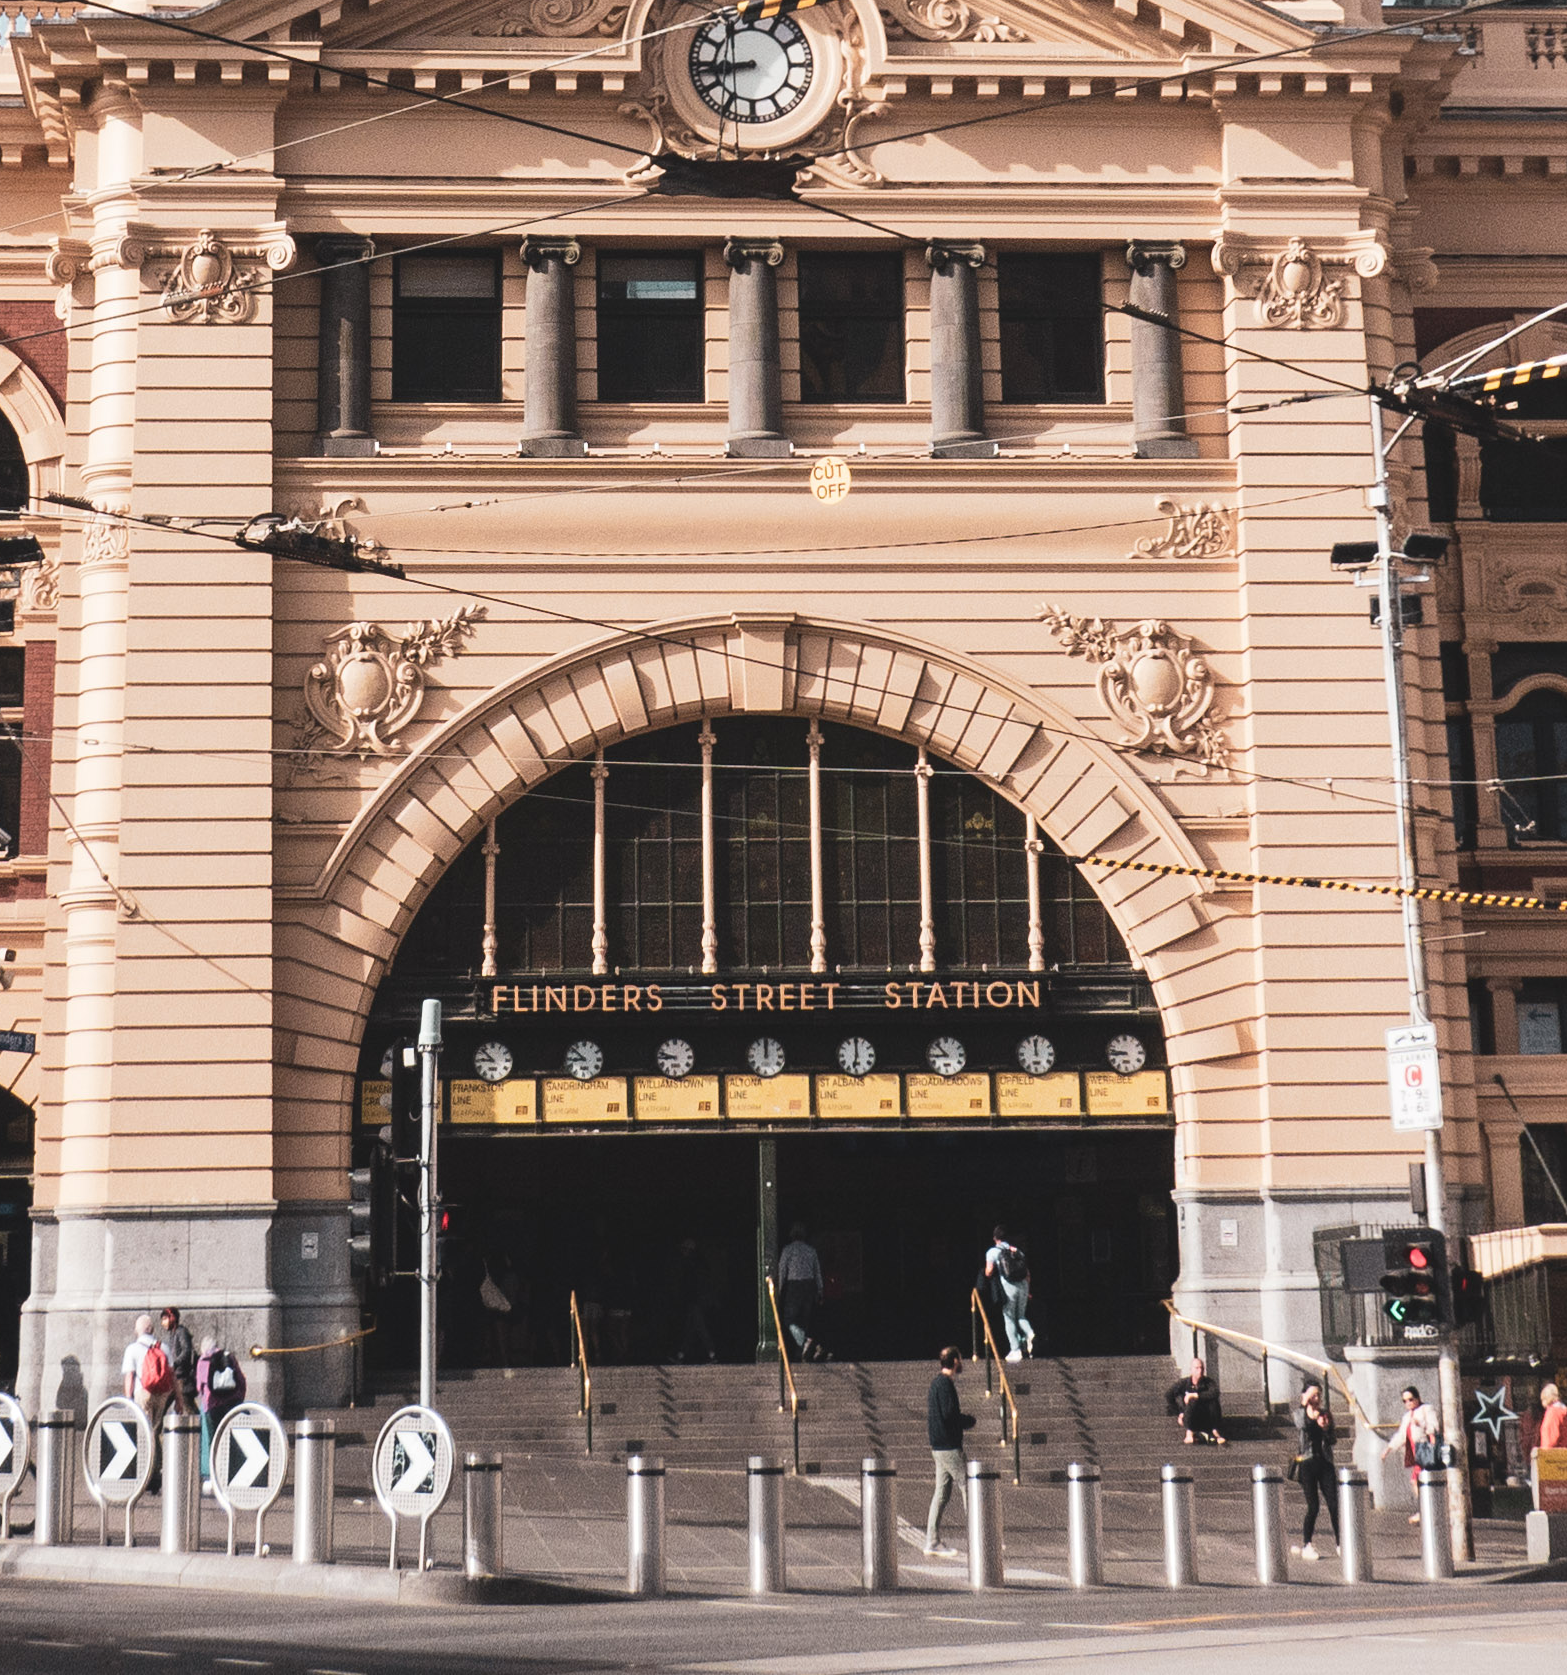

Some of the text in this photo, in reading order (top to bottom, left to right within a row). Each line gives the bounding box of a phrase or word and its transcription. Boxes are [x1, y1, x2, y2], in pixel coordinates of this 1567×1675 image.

[813, 464, 844, 481] CUT
[816, 482, 846, 499] OFF
[492, 980, 1041, 1013] FLINDERS STREET STATION
[638, 1079, 704, 1089] WILLIAMSTOWN
[729, 1077, 763, 1087] ALTONA
[819, 1077, 866, 1088] ST ALBANS
[910, 1076, 983, 1087] BROADMEADOWS
[1000, 1076, 1035, 1085] UPFIELD
[1089, 1075, 1133, 1085] WERRIBEE
[452, 1083, 505, 1093] FRANKSTON
[545, 1081, 610, 1091] SANDRINGHAM
[638, 1092, 657, 1101] LINE
[729, 1089, 748, 1099] LINE
[820, 1090, 838, 1100] LINE
[910, 1089, 929, 1099] LINE
[1000, 1088, 1019, 1097] LINE
[1089, 1087, 1109, 1097] LINE
[452, 1096, 472, 1106] LINE
[546, 1094, 565, 1103] LINE
